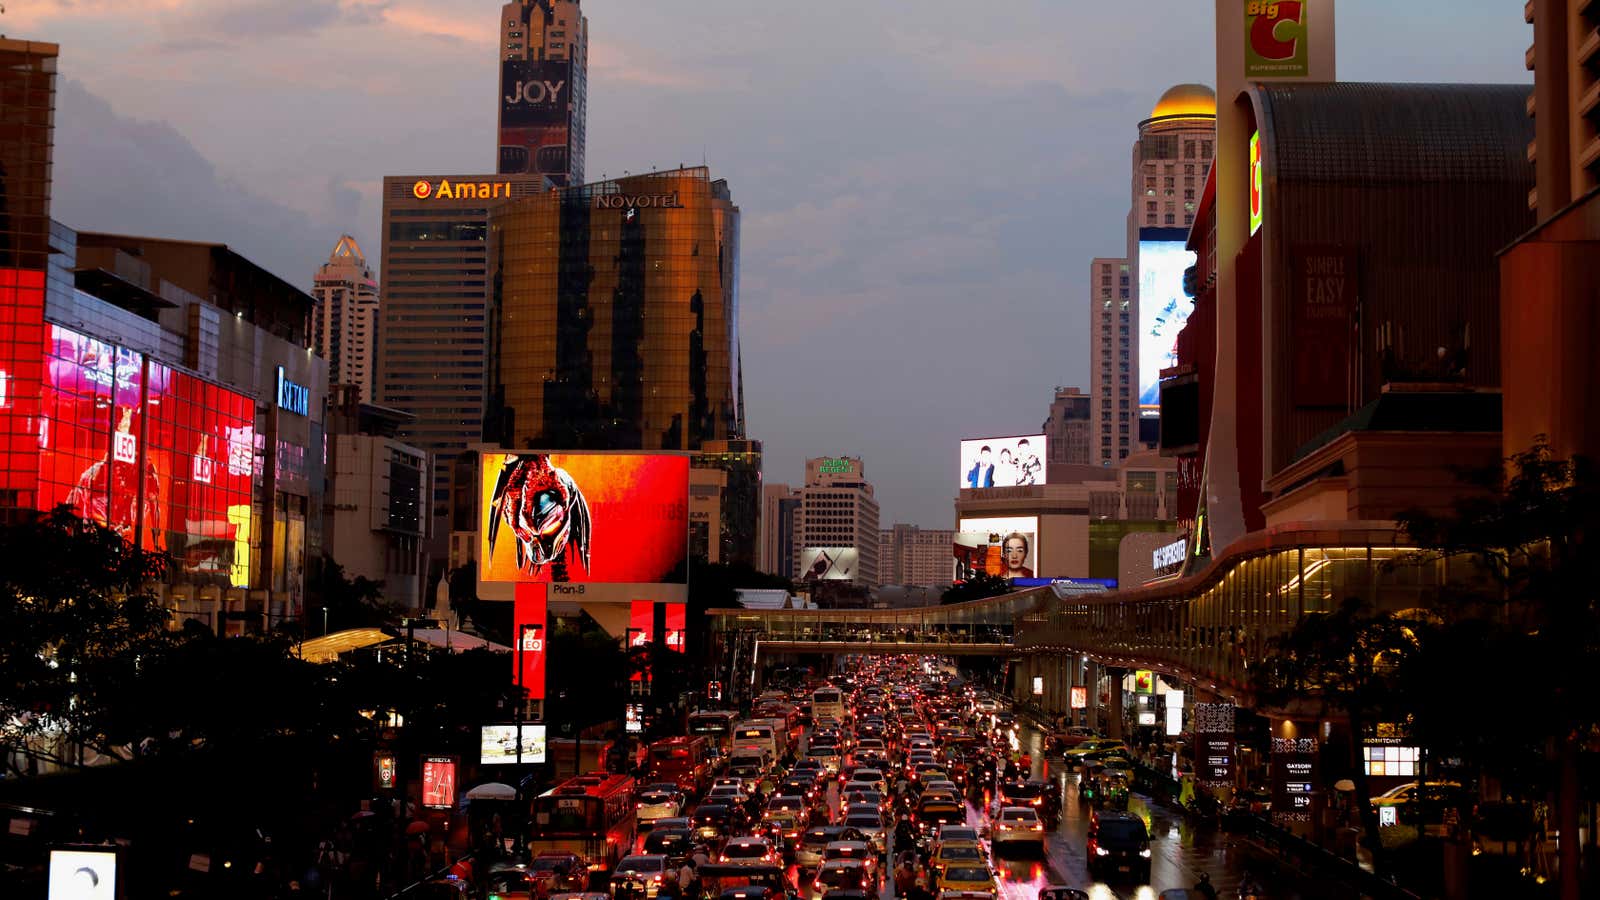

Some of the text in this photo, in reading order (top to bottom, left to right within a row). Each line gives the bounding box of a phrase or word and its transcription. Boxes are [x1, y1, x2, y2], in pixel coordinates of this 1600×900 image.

[1247, 0, 1279, 20] Big
[1250, 0, 1302, 61] C
[505, 80, 565, 104] JOY
[435, 179, 511, 200] Amari
[596, 192, 684, 208] NOVOTEL
[1305, 256, 1344, 274] SIMPLE
[1306, 278, 1344, 304] EASY
[277, 365, 309, 417] ISETAN
[116, 436, 133, 459] LEO
[195, 458, 210, 478] LO
[521, 640, 541, 650] EO
[1294, 796, 1304, 804] IN
